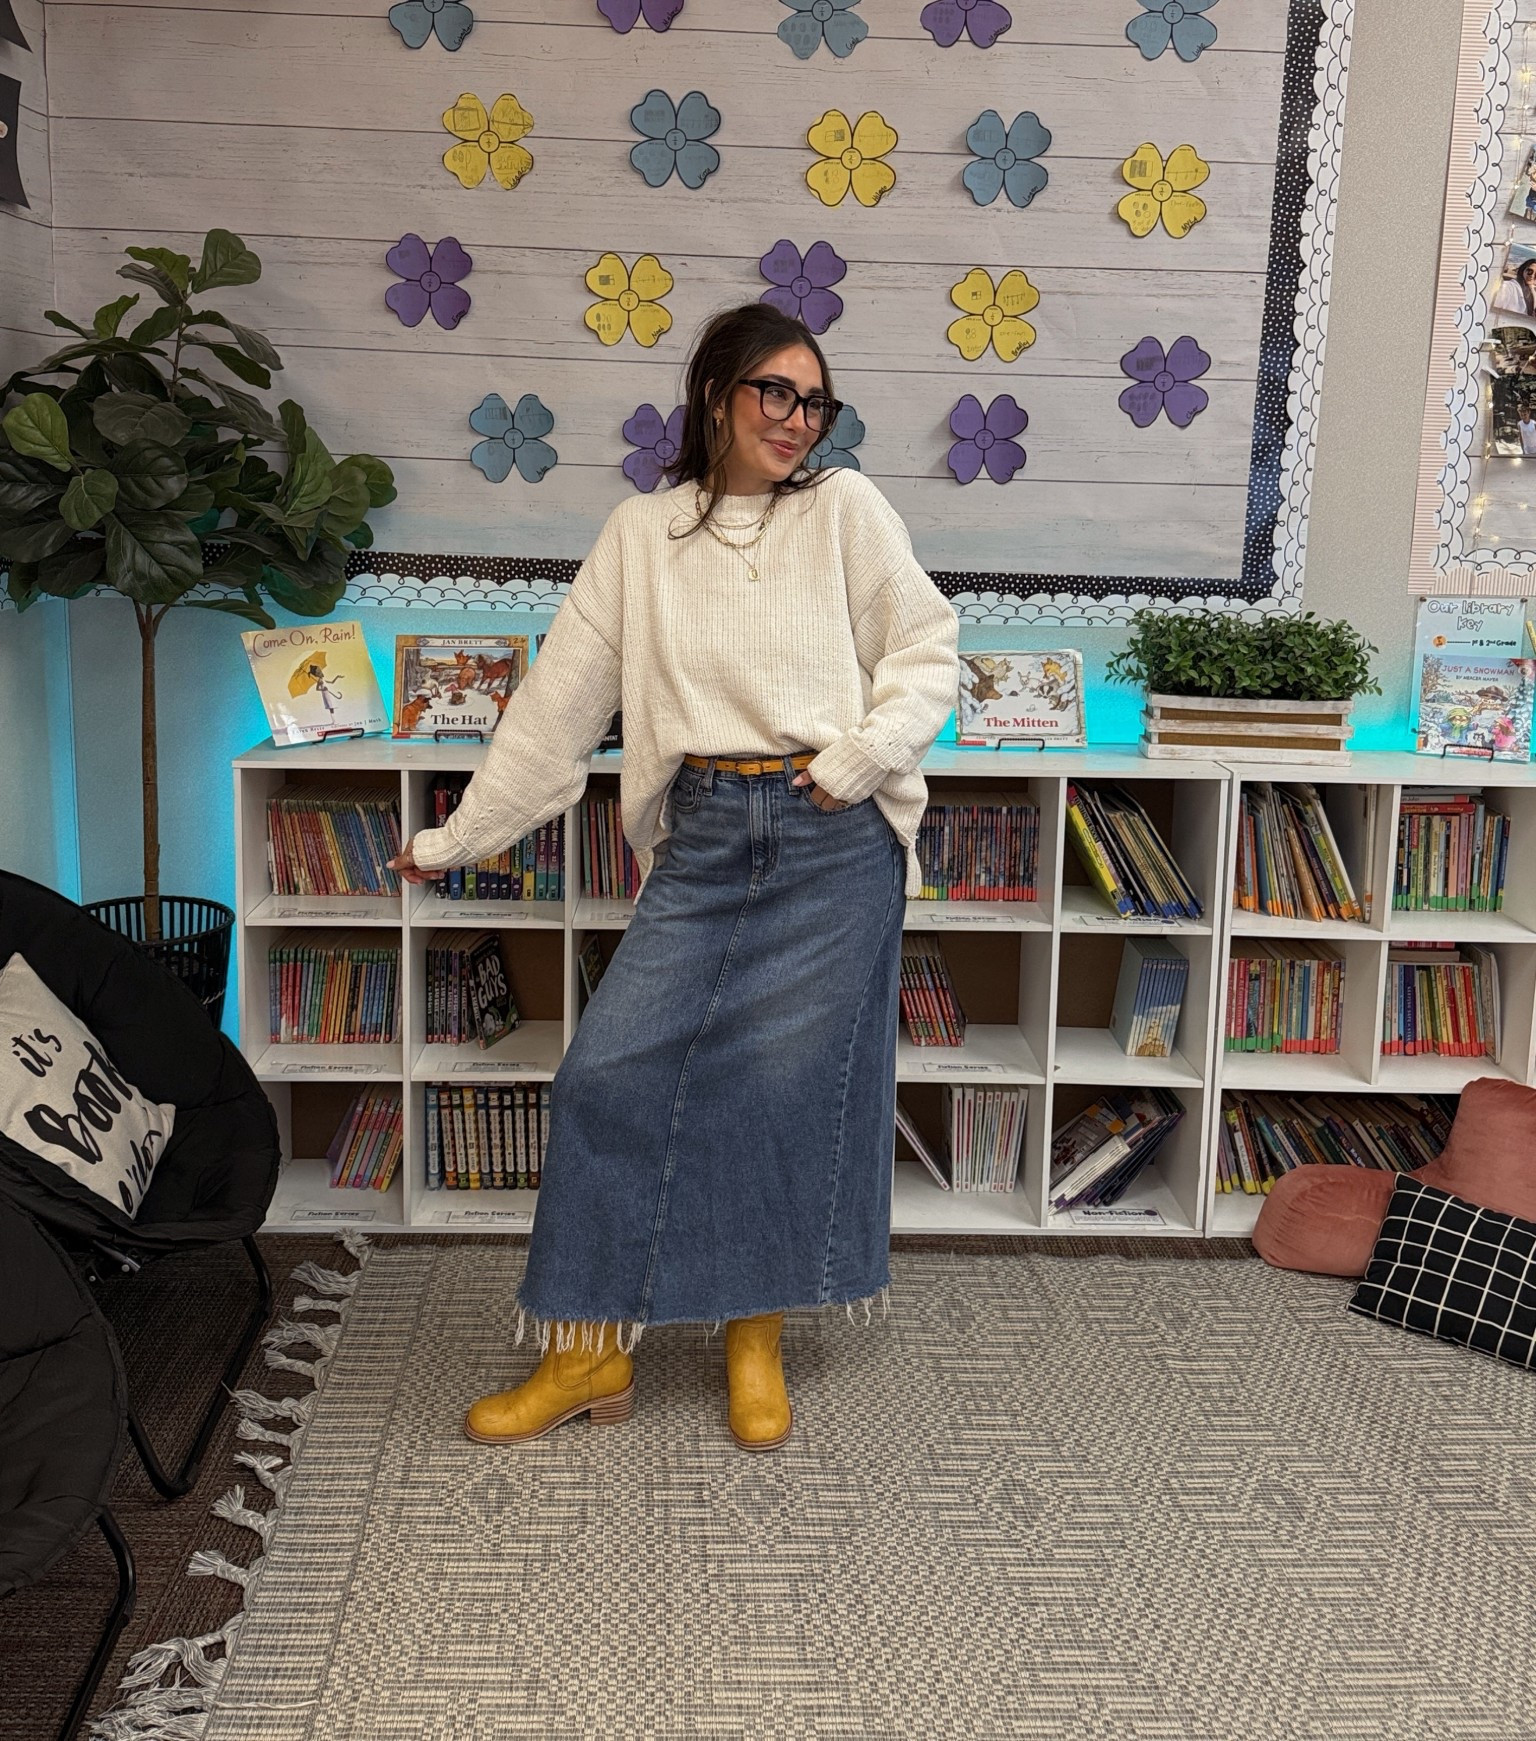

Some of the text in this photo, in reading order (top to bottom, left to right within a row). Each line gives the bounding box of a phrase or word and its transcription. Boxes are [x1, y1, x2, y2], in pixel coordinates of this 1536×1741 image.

[652, 325, 664, 340] Noah
[1010, 340, 1030, 357] Bradley
[1428, 600, 1458, 614] Our
[253, 633, 288, 658] Come
[320, 624, 356, 644] Rain!
[1474, 667, 1514, 675] SNOWMAN
[431, 714, 488, 725] The Hat
[984, 717, 1058, 728] The Mitten
[478, 954, 500, 986] BAD
[478, 973, 507, 1008] GUYS
[12, 1028, 62, 1078] it's
